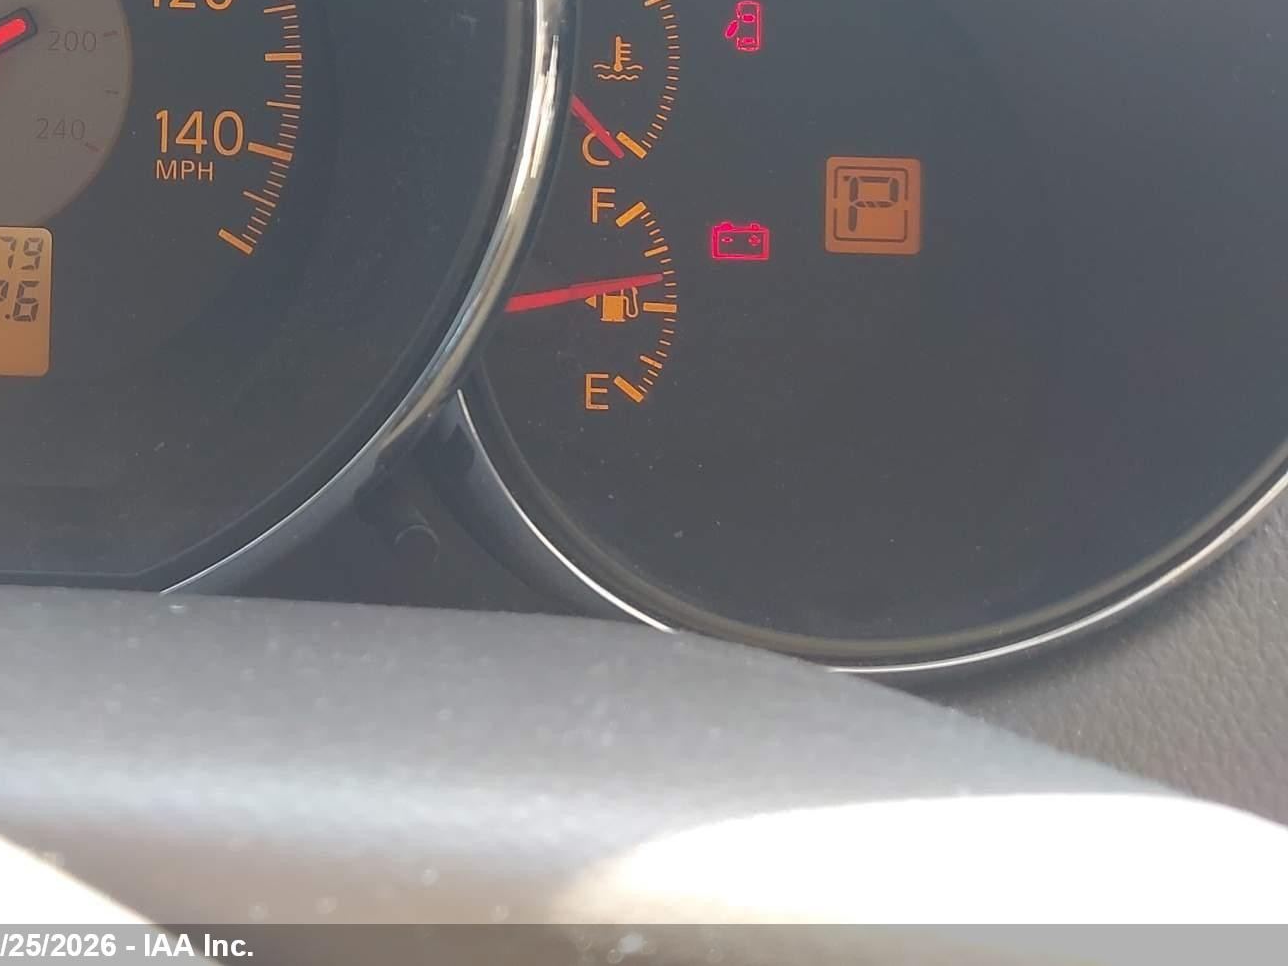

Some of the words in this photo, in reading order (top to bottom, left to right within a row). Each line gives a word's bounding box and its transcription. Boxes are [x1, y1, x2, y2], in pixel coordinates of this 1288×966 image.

[47, 30, 98, 54] 200
[35, 118, 86, 141] 240
[156, 110, 245, 157] 140
[581, 130, 611, 166] C
[156, 160, 215, 182] MPH
[591, 187, 616, 224] F
[843, 176, 899, 232] P
[585, 373, 609, 410] E
